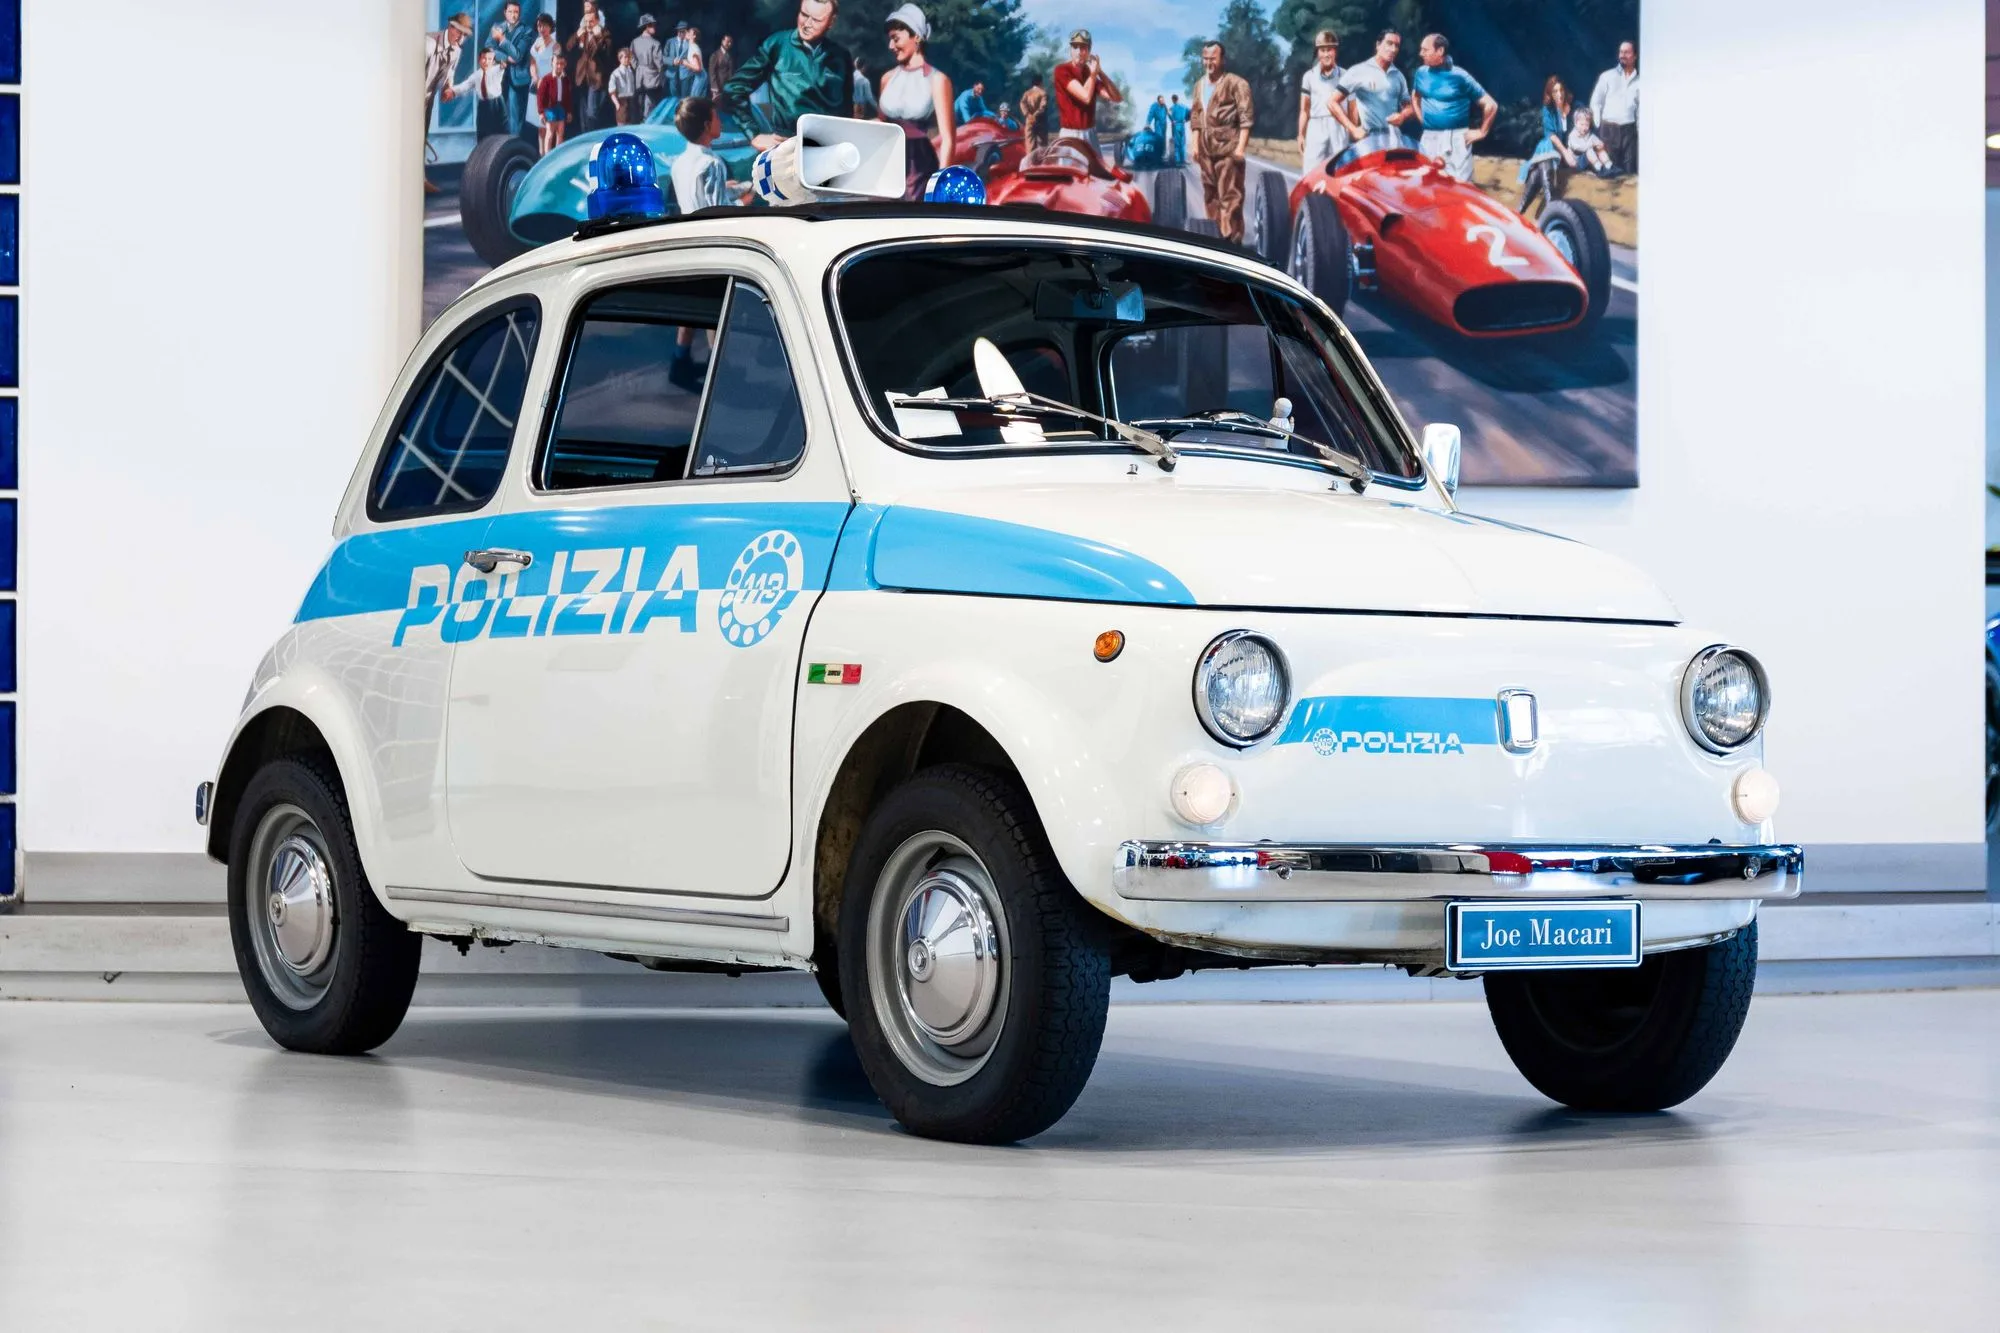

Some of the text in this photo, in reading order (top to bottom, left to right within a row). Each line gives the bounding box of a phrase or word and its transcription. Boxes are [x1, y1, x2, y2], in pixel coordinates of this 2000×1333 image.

[1466, 225, 1531, 268] 2
[393, 546, 784, 647] POLIZIA 113
[1342, 731, 1464, 754] POLIZIA
[1480, 918, 1613, 950] Joe Macari
